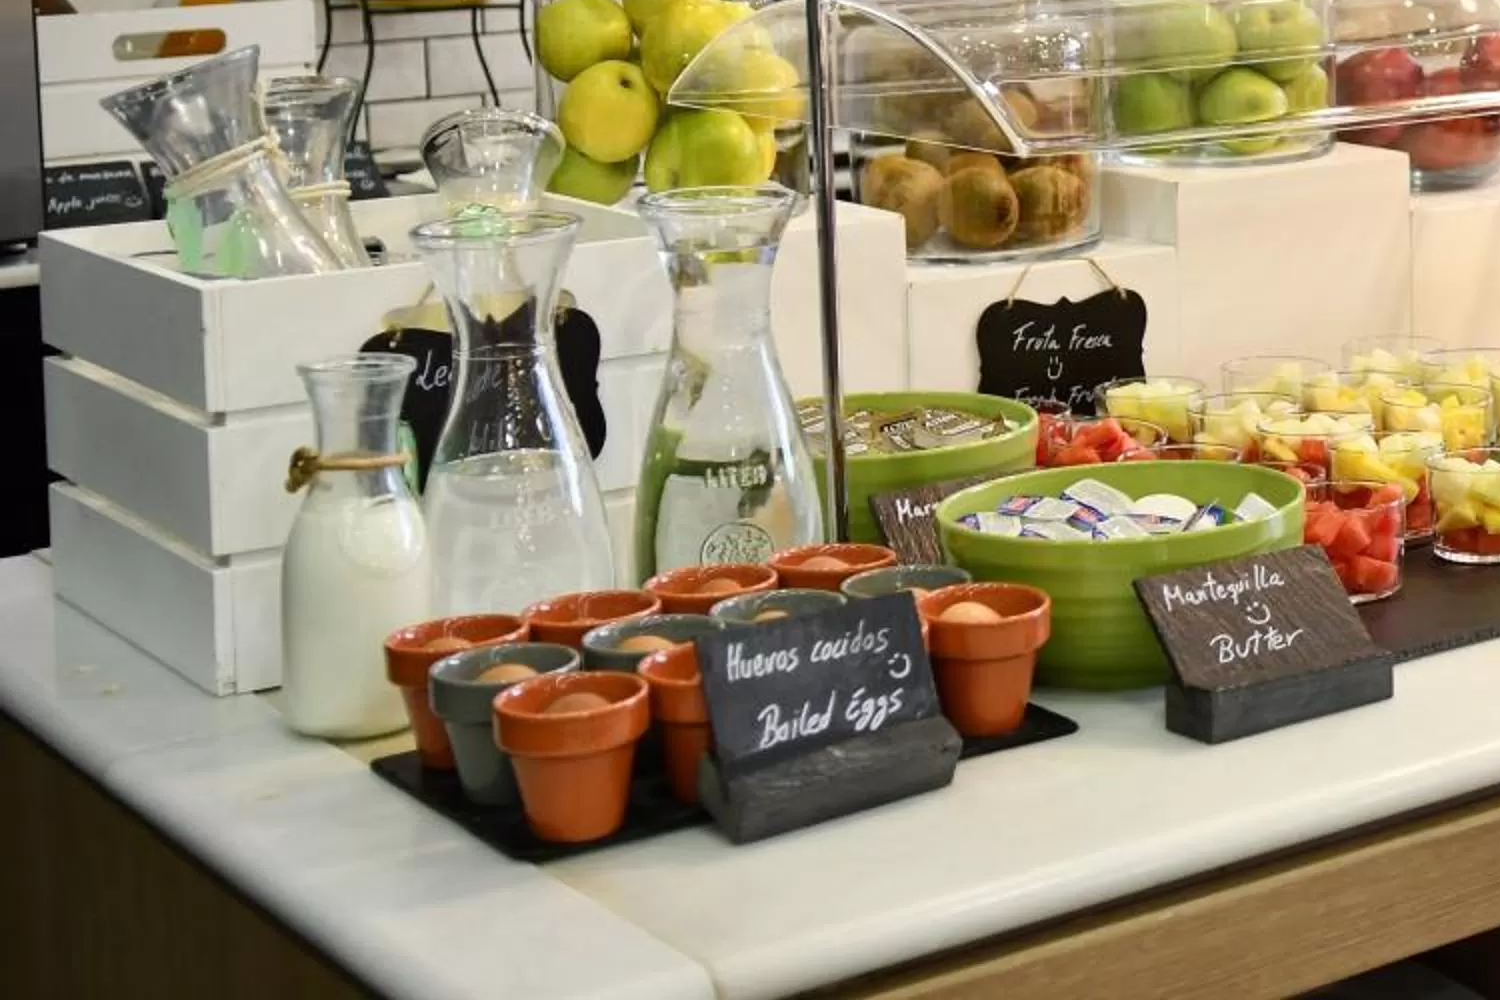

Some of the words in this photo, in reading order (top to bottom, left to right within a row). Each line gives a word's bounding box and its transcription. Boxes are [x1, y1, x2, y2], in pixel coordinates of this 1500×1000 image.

[895, 498, 940, 523] Mar
[1162, 563, 1285, 612] Mantequilla
[726, 641, 801, 683] Huevos
[809, 617, 892, 664] cocidos
[1209, 626, 1304, 664] Butter
[756, 689, 837, 750] Boiled
[844, 686, 904, 732] Eggs
